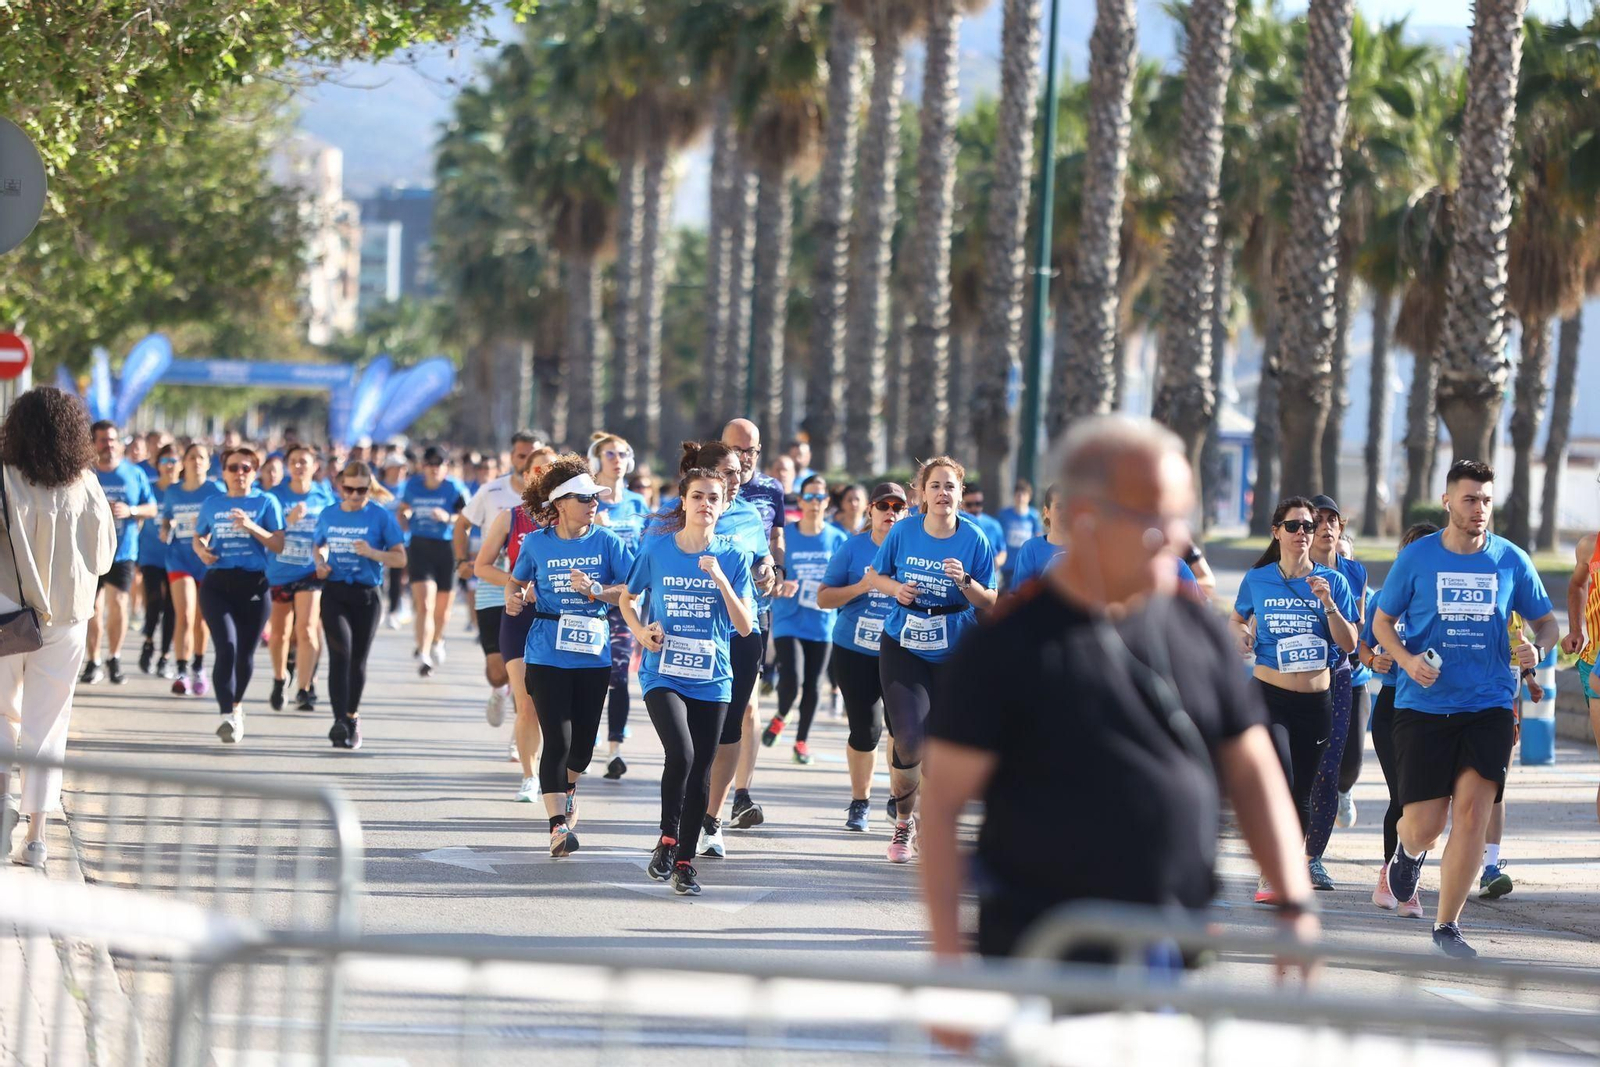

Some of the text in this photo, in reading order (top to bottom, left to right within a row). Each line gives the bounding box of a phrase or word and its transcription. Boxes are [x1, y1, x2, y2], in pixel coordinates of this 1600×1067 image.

[327, 526, 369, 536] mayoral
[547, 554, 602, 568] mayoral
[906, 556, 946, 571] mayor
[1450, 589, 1484, 602] 730
[666, 602, 710, 611] MAKES
[1264, 598, 1320, 609] mayoral
[666, 610, 711, 618] FRIENDS
[1441, 614, 1490, 622] FRIENDS
[568, 631, 597, 643] 497
[910, 630, 937, 641] 565
[672, 653, 704, 667] 252
[1288, 648, 1318, 661] 842
